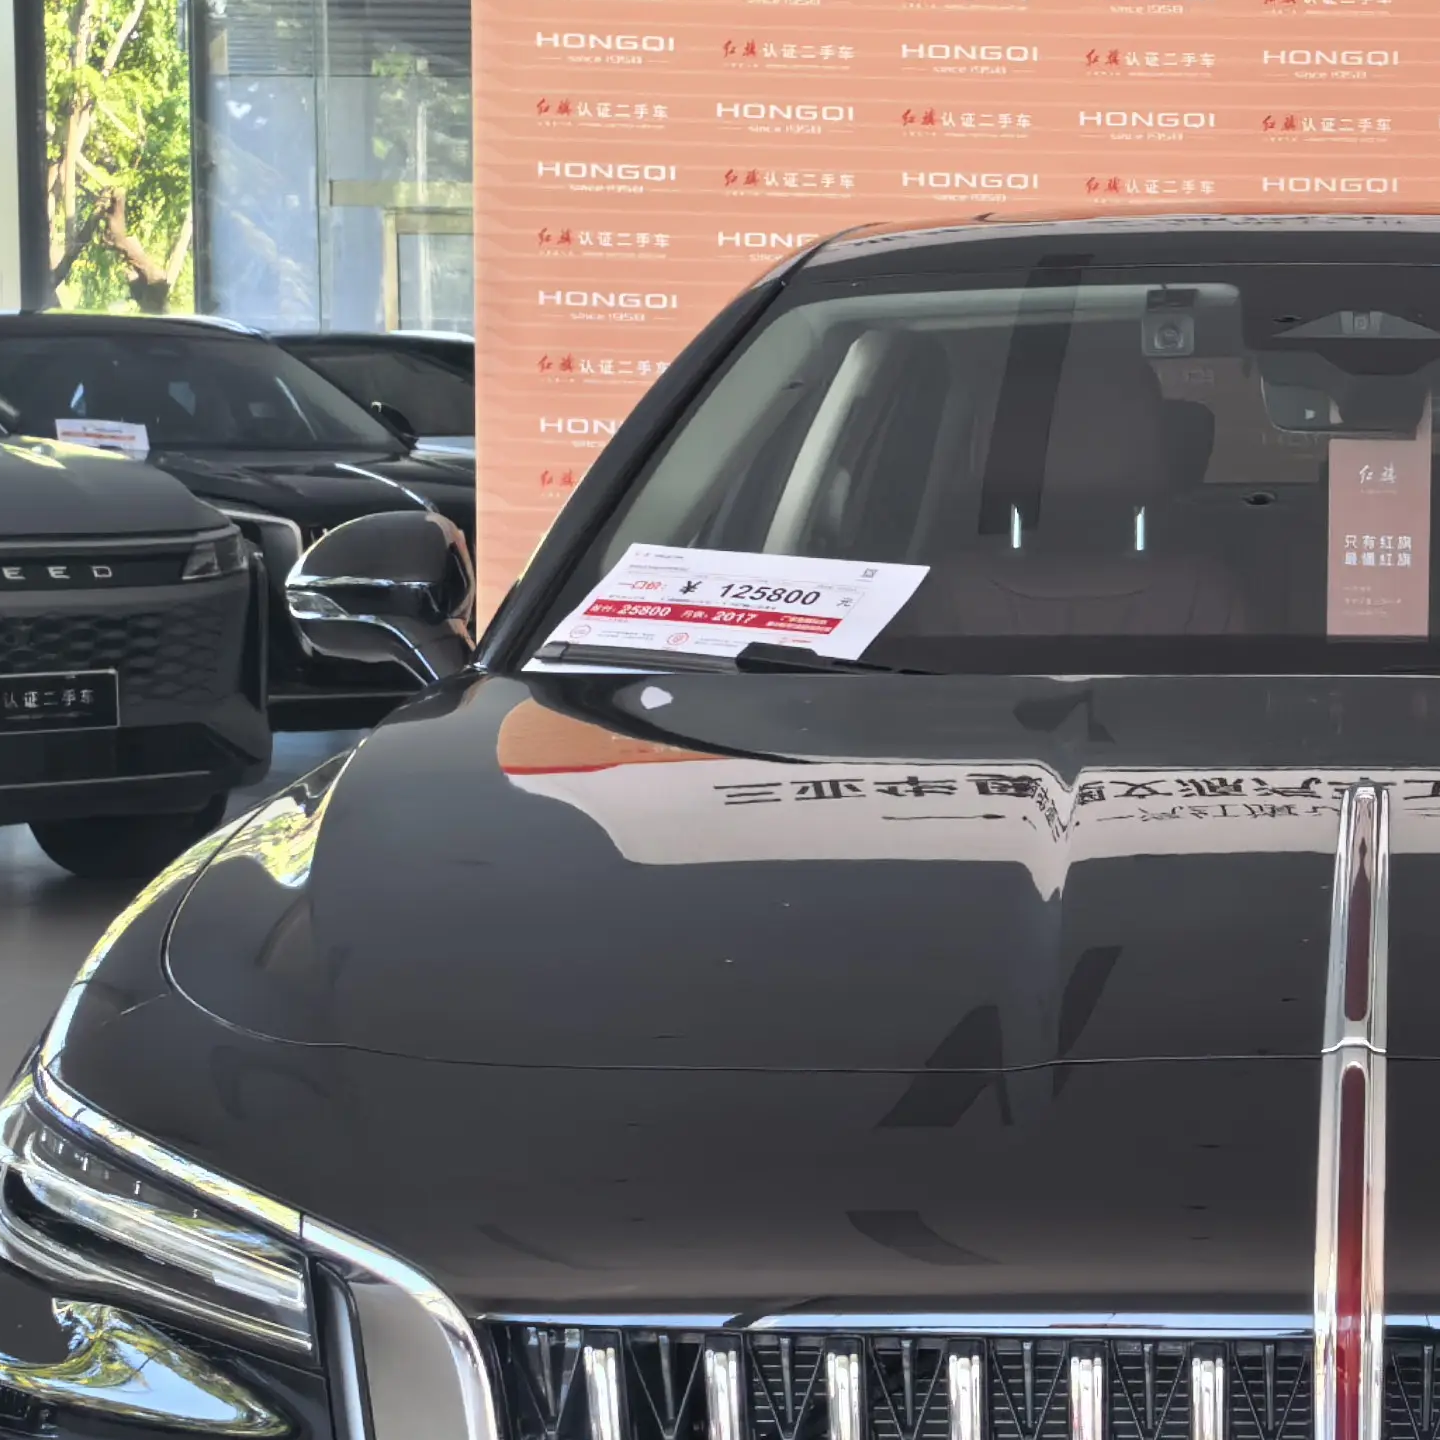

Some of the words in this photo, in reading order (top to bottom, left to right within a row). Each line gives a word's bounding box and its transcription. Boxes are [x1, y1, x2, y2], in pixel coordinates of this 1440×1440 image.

[535, 31, 675, 53] HONGQI
[901, 43, 1039, 62] HONGQI
[1262, 49, 1400, 67] HONGQI
[716, 102, 854, 122] HONGQI
[1078, 111, 1216, 129] HONGQI
[536, 161, 677, 182] HONGQI
[901, 171, 1039, 190] HONGQI
[1261, 176, 1398, 194] HONGQI
[717, 231, 819, 248] HONG
[538, 290, 678, 310] HONGQI
[539, 416, 617, 436] HON
[720, 583, 821, 606] 125800
[836, 597, 853, 607] 元
[617, 603, 672, 617] 25800
[711, 610, 759, 624] 2017
